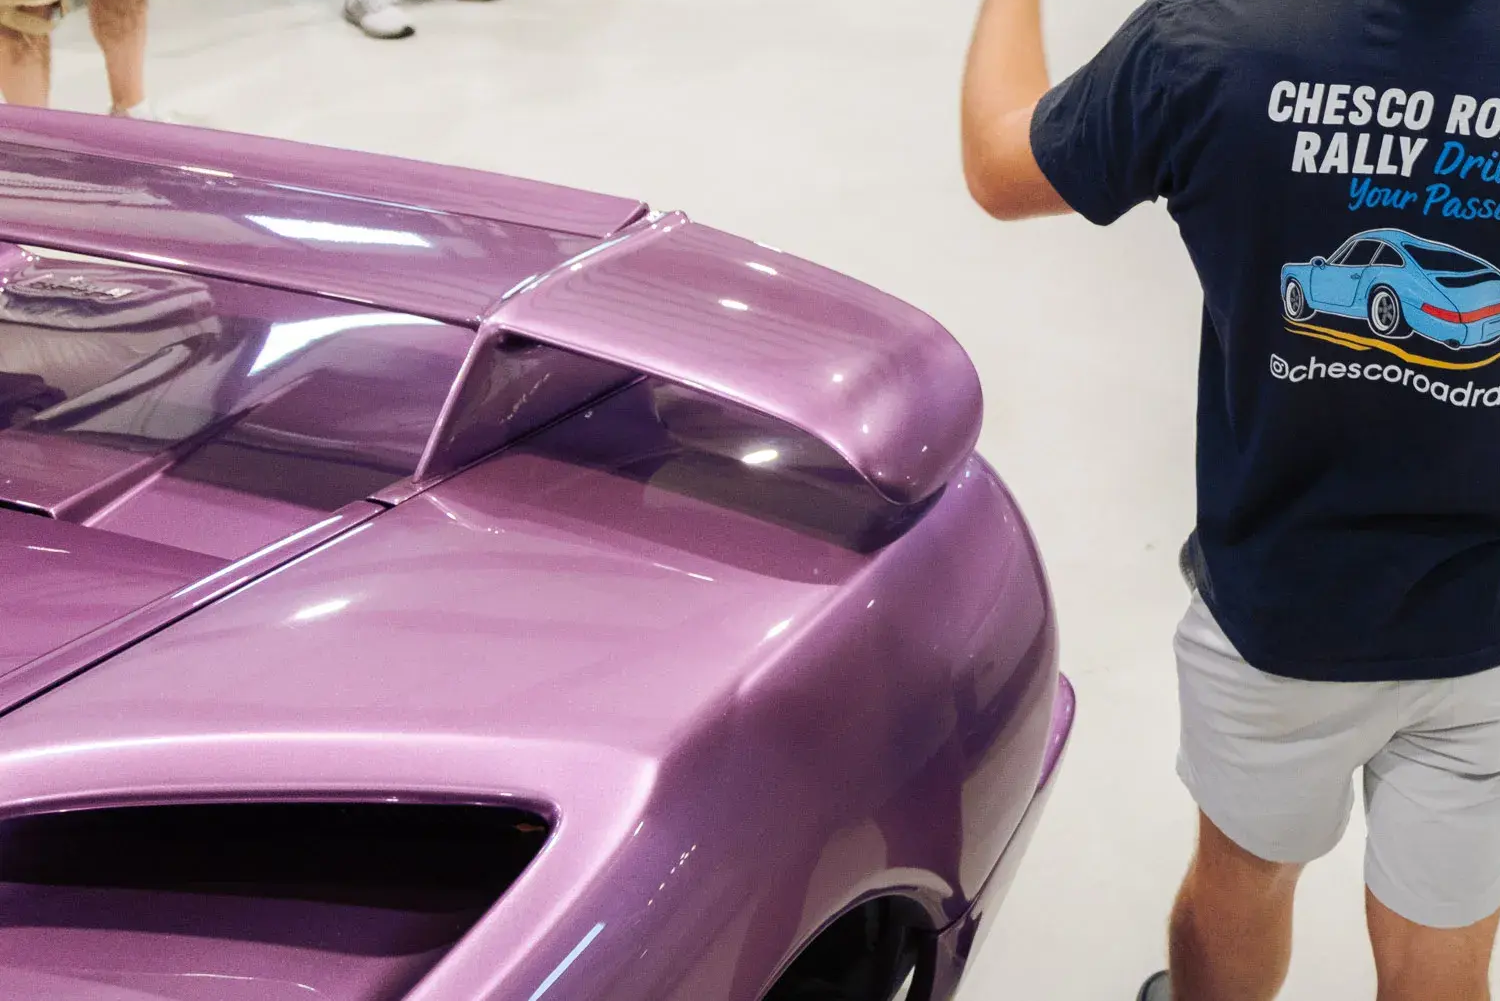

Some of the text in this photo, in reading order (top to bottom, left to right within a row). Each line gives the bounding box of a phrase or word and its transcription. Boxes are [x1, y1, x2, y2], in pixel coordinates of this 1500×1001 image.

[1267, 80, 1435, 128] CHESCO
[1291, 130, 1429, 178] RALLY
[1347, 176, 1418, 211] Your
